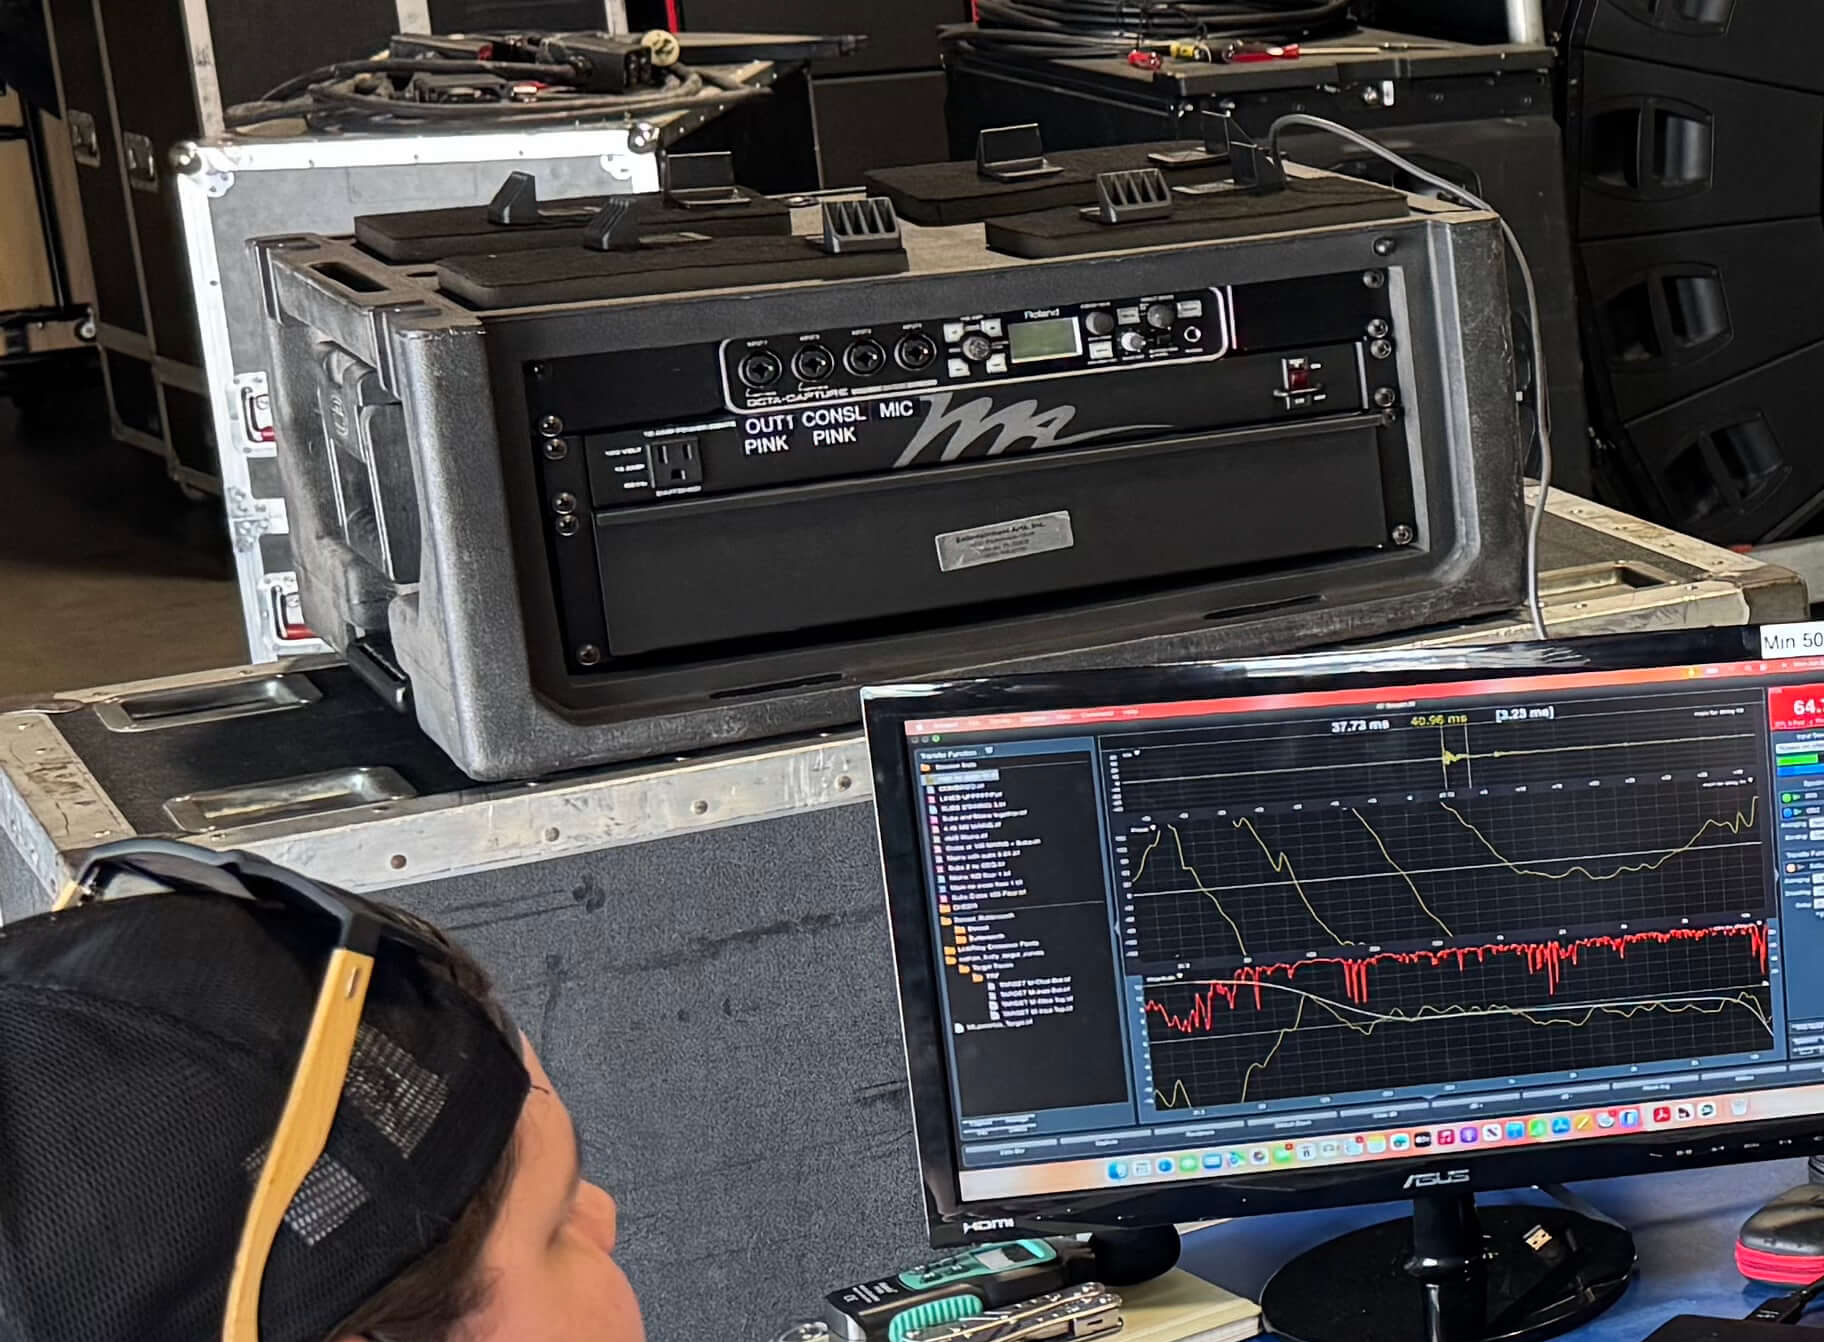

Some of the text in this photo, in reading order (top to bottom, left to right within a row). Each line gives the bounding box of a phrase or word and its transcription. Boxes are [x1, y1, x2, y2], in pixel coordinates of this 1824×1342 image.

[745, 400, 914, 435] OUT1 CONSL MIC
[744, 426, 857, 455] PINK PINK
[1763, 634, 1796, 650] Min
[1803, 632, 1823, 648] 50
[1331, 720, 1366, 733] 37.73
[1402, 1167, 1472, 1191] ASUS
[963, 1215, 1015, 1234] HDMI
